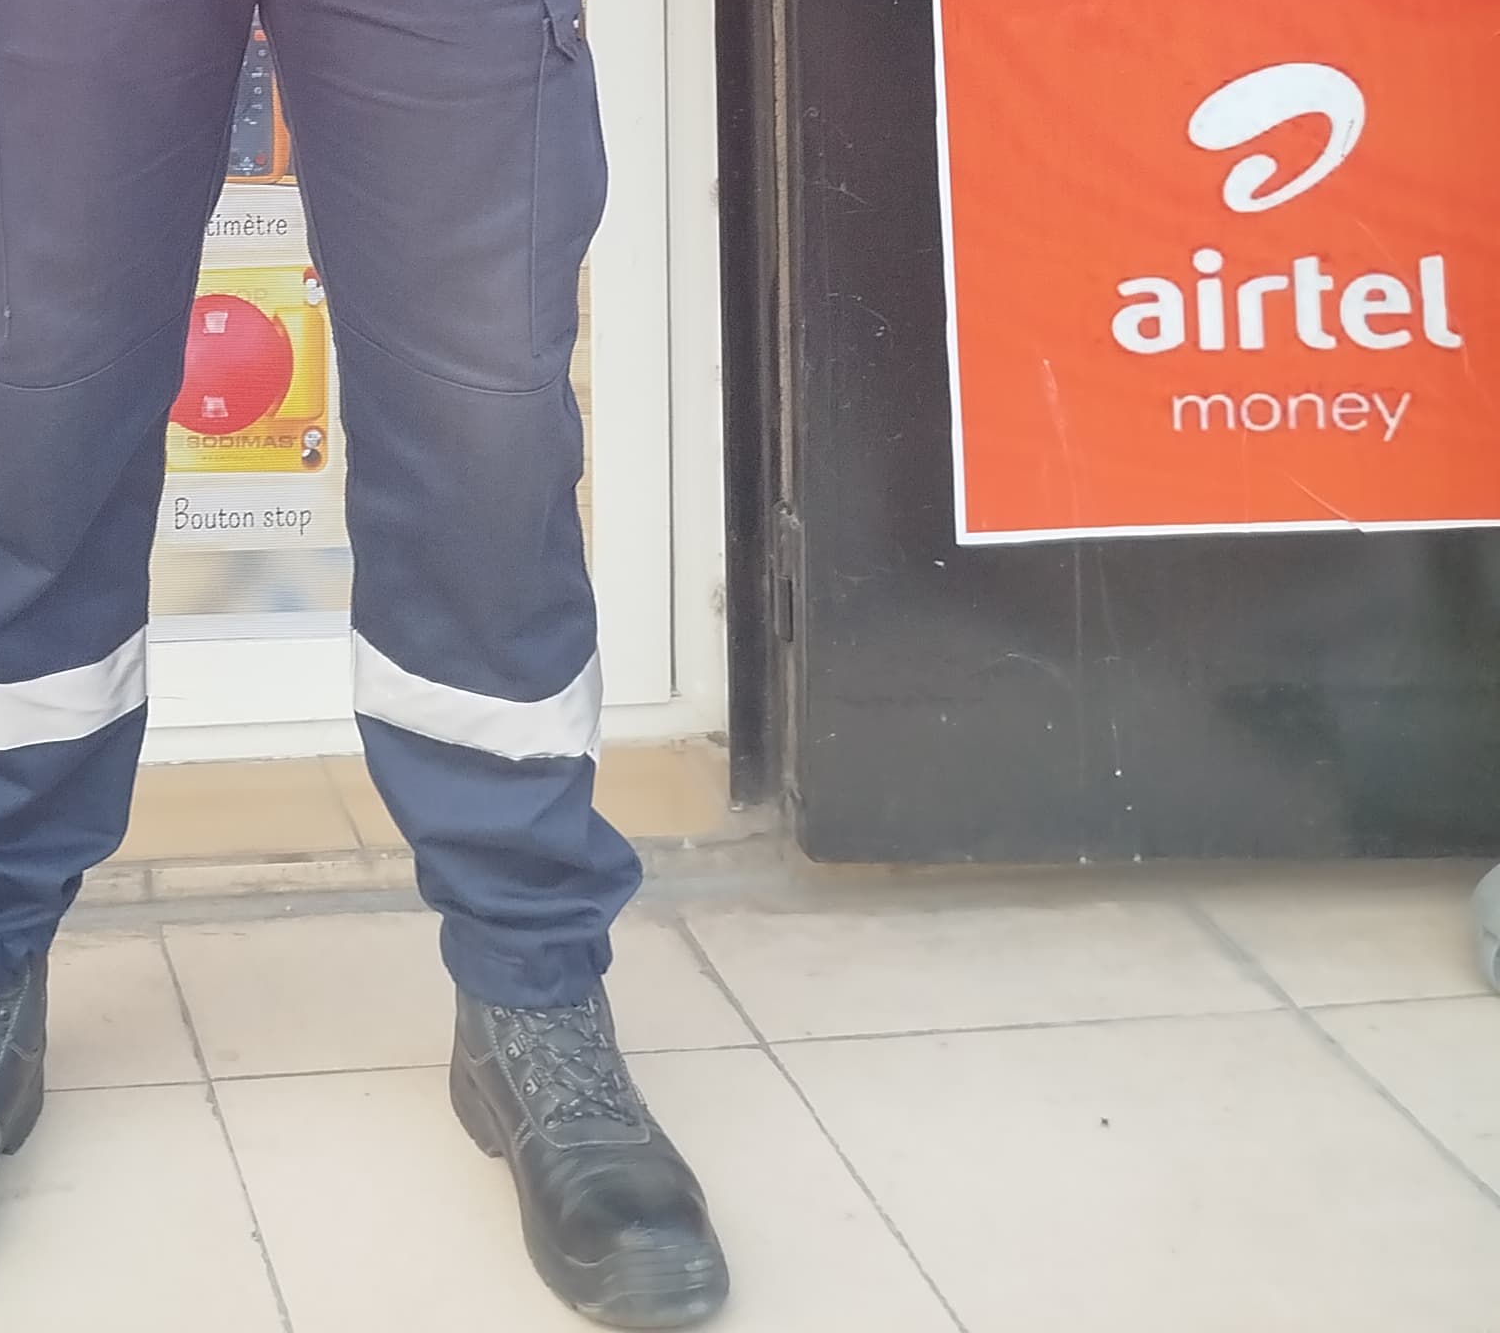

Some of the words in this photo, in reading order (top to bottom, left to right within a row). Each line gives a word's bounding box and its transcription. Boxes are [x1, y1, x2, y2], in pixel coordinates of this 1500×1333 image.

[1112, 248, 1462, 354] airtel
[1172, 391, 1411, 442] money
[174, 496, 254, 530] Bouton
[263, 505, 312, 536] stop
